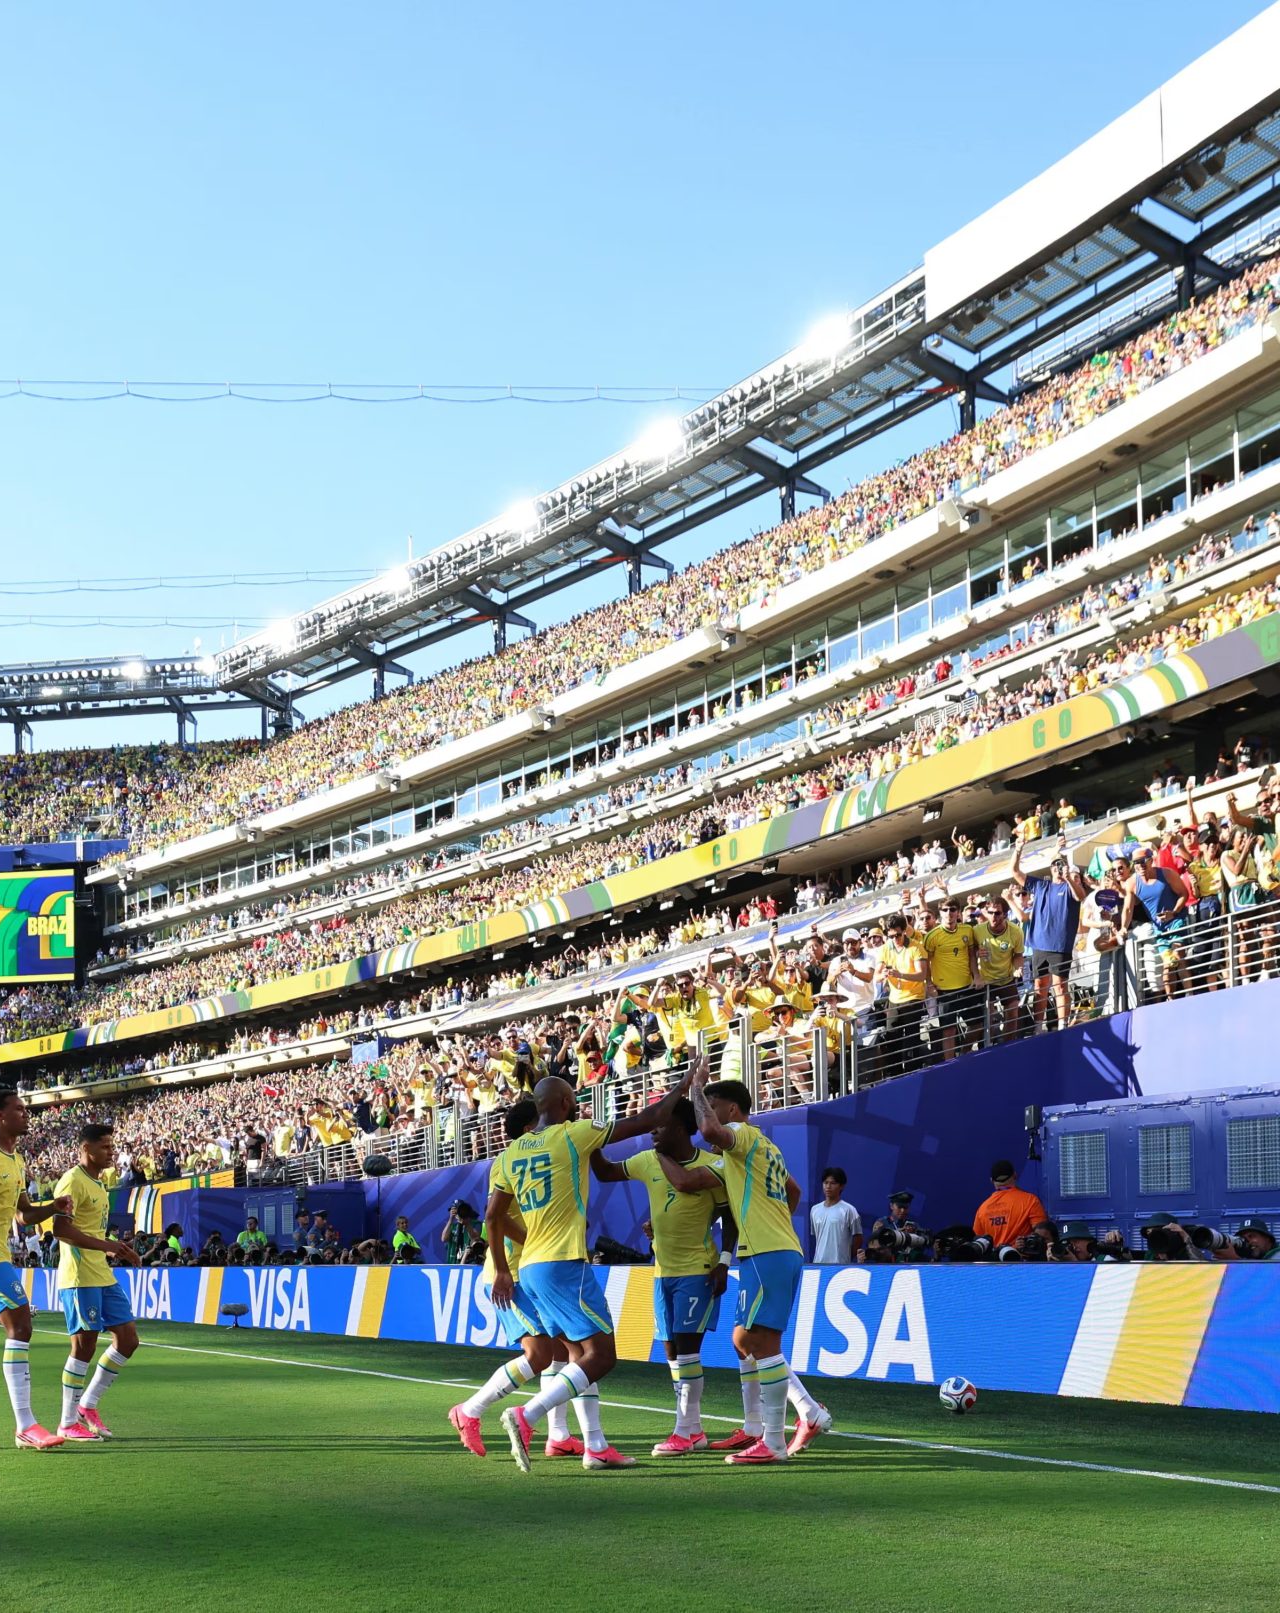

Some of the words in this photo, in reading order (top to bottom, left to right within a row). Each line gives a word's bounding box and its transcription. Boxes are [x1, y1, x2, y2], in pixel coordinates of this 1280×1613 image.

[511, 1152, 552, 1213] 25
[664, 1192, 675, 1212] 7
[126, 1268, 171, 1320] VISA
[243, 1267, 311, 1331] VISA
[421, 1267, 511, 1348] VIS
[688, 1296, 699, 1318] 7
